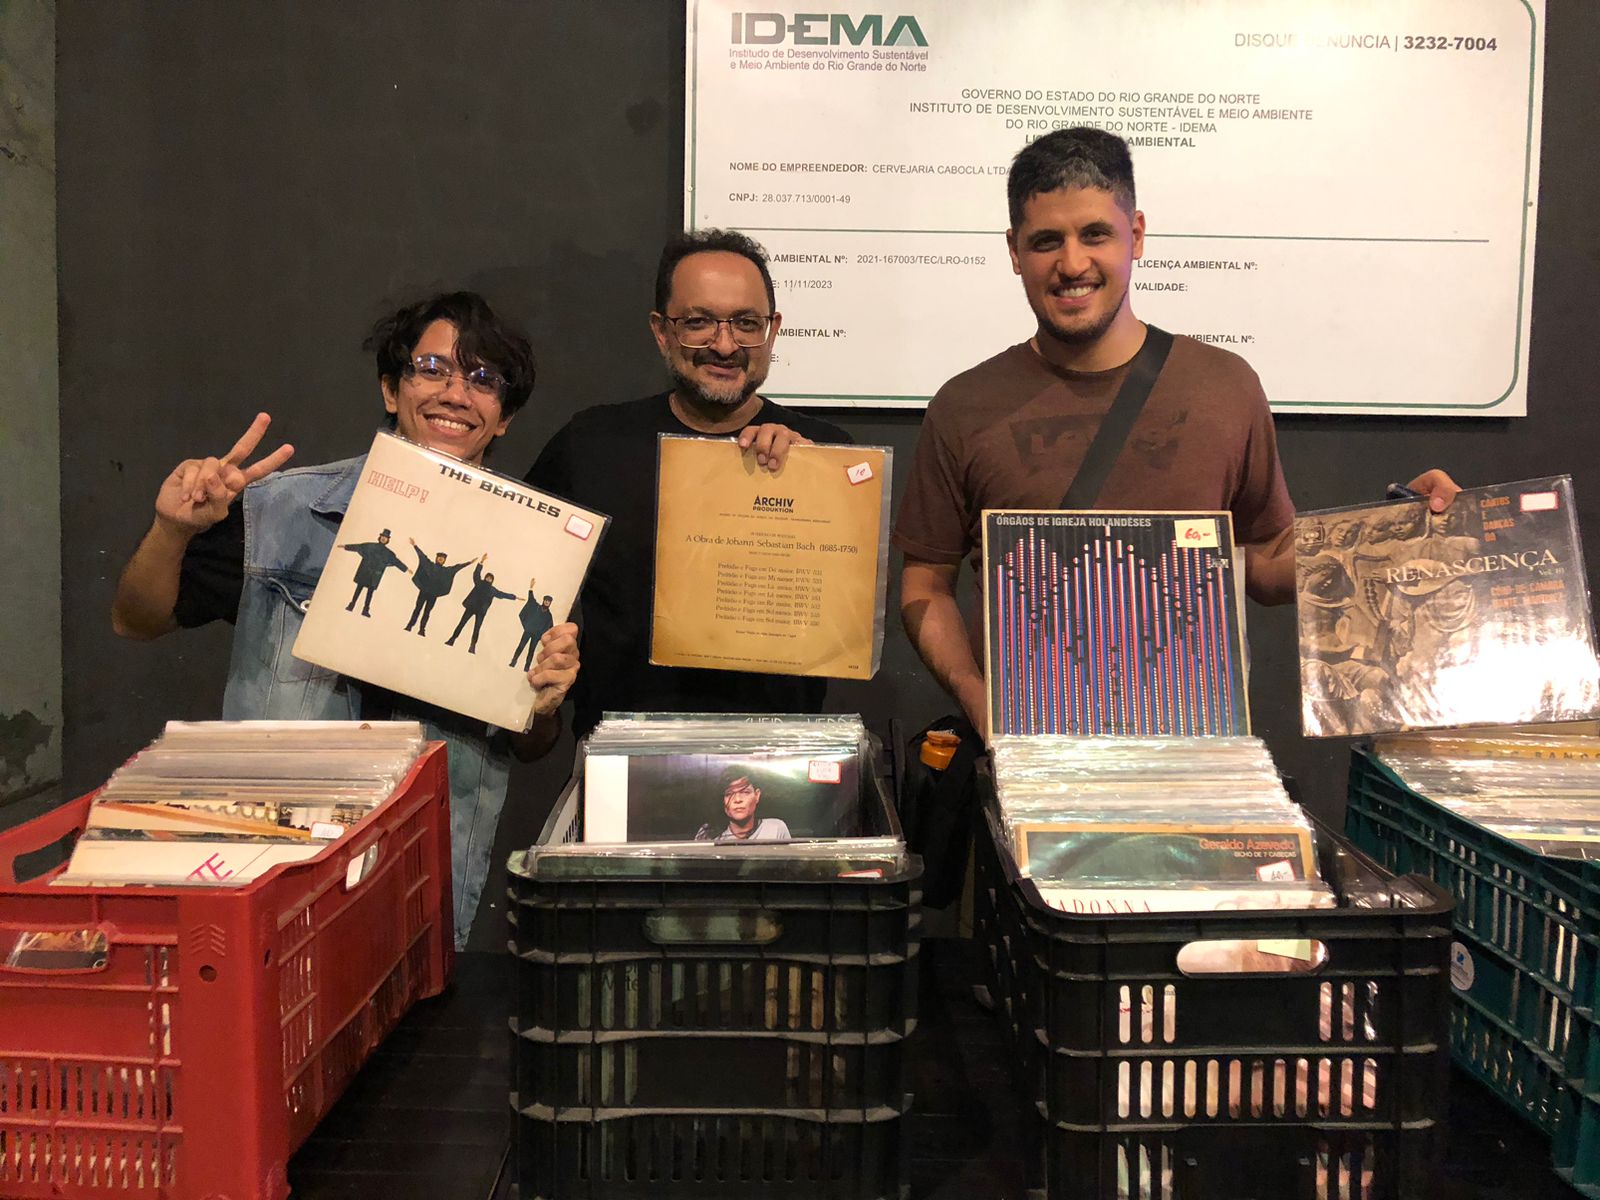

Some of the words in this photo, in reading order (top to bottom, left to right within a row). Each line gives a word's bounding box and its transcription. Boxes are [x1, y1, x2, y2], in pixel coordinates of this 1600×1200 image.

[731, 12, 929, 47] IDEMA
[1234, 33, 1296, 48] DISQU
[1403, 35, 1498, 51] 3232-7004
[772, 49, 785, 59] de
[787, 48, 870, 60] Desenvolvimento
[872, 50, 929, 61] Sustentável
[730, 62, 737, 70] e
[739, 60, 763, 70] Meio
[764, 60, 810, 70] Ambiente
[812, 60, 825, 71] do
[827, 61, 844, 71] Rio
[846, 61, 883, 71] Grande
[885, 61, 898, 72] do
[900, 62, 927, 72] Norte
[961, 88, 1022, 100] GOVERNO
[1025, 90, 1043, 101] DO
[1046, 90, 1095, 102] ESTADO
[1098, 91, 1116, 102] DO
[1119, 92, 1141, 103] RIO
[1143, 92, 1194, 104] GRANDE
[1197, 93, 1216, 104] DO
[1218, 94, 1261, 105] NORTE
[909, 102, 972, 114] INSTITUTO
[976, 103, 992, 114] DE
[996, 104, 1115, 117] DESENVOLVIMENTO
[1118, 106, 1204, 119] SUSTENTÁVEL
[1207, 108, 1215, 119] E
[1218, 108, 1250, 120] MEIO
[1252, 109, 1314, 121] AMBIENTE
[1005, 119, 1024, 129] DO
[1026, 119, 1048, 130] RIO
[1105, 121, 1123, 131] DO
[1126, 122, 1168, 133] NORTE
[1179, 123, 1217, 133] IDEMA
[1127, 137, 1196, 147] AMBIENTAL
[729, 161, 760, 172] NOME
[761, 162, 778, 172] DO
[780, 162, 868, 173] EMPREENDEDOR:
[872, 164, 935, 175] CERVEJARIA
[937, 165, 985, 175] CABOCLA
[728, 193, 759, 203] CNPJ:
[761, 193, 852, 204] 28.037.713/0001-49
[773, 254, 832, 264] AMBIENTAL
[834, 254, 848, 265] Nº:
[857, 254, 987, 266] 2021-167003/TEC/LRO-0152
[1137, 259, 1181, 270] LICENÇA
[1183, 260, 1242, 270] AMBIENTAL
[1243, 261, 1258, 270] Nº:
[783, 279, 833, 289] 11/11/2023
[1134, 282, 1188, 292] VALIDADE:
[832, 328, 847, 338] Nº:
[1240, 335, 1255, 344] Nº:
[367, 470, 430, 504] HELP!
[438, 463, 473, 485] THE
[479, 479, 562, 519] BEATLES
[753, 495, 795, 508] ARCHIV
[752, 506, 795, 514] PRODUKTION
[996, 515, 1035, 527] ÓRGÃOS
[1037, 517, 1050, 526] DE
[1052, 517, 1087, 527] IGREJA
[685, 534, 693, 543] A
[693, 534, 714, 544] Obra
[714, 536, 725, 545] de
[726, 536, 754, 547] Johann
[756, 537, 794, 549] Sebastian
[796, 541, 816, 551] Bach
[819, 543, 859, 554] (1685-1750)
[1385, 549, 1560, 584] RENASCENÇA
[1200, 838, 1244, 850] Geraldo
[1246, 838, 1295, 850] Azevedo
[1046, 899, 1151, 914] ADONNA
